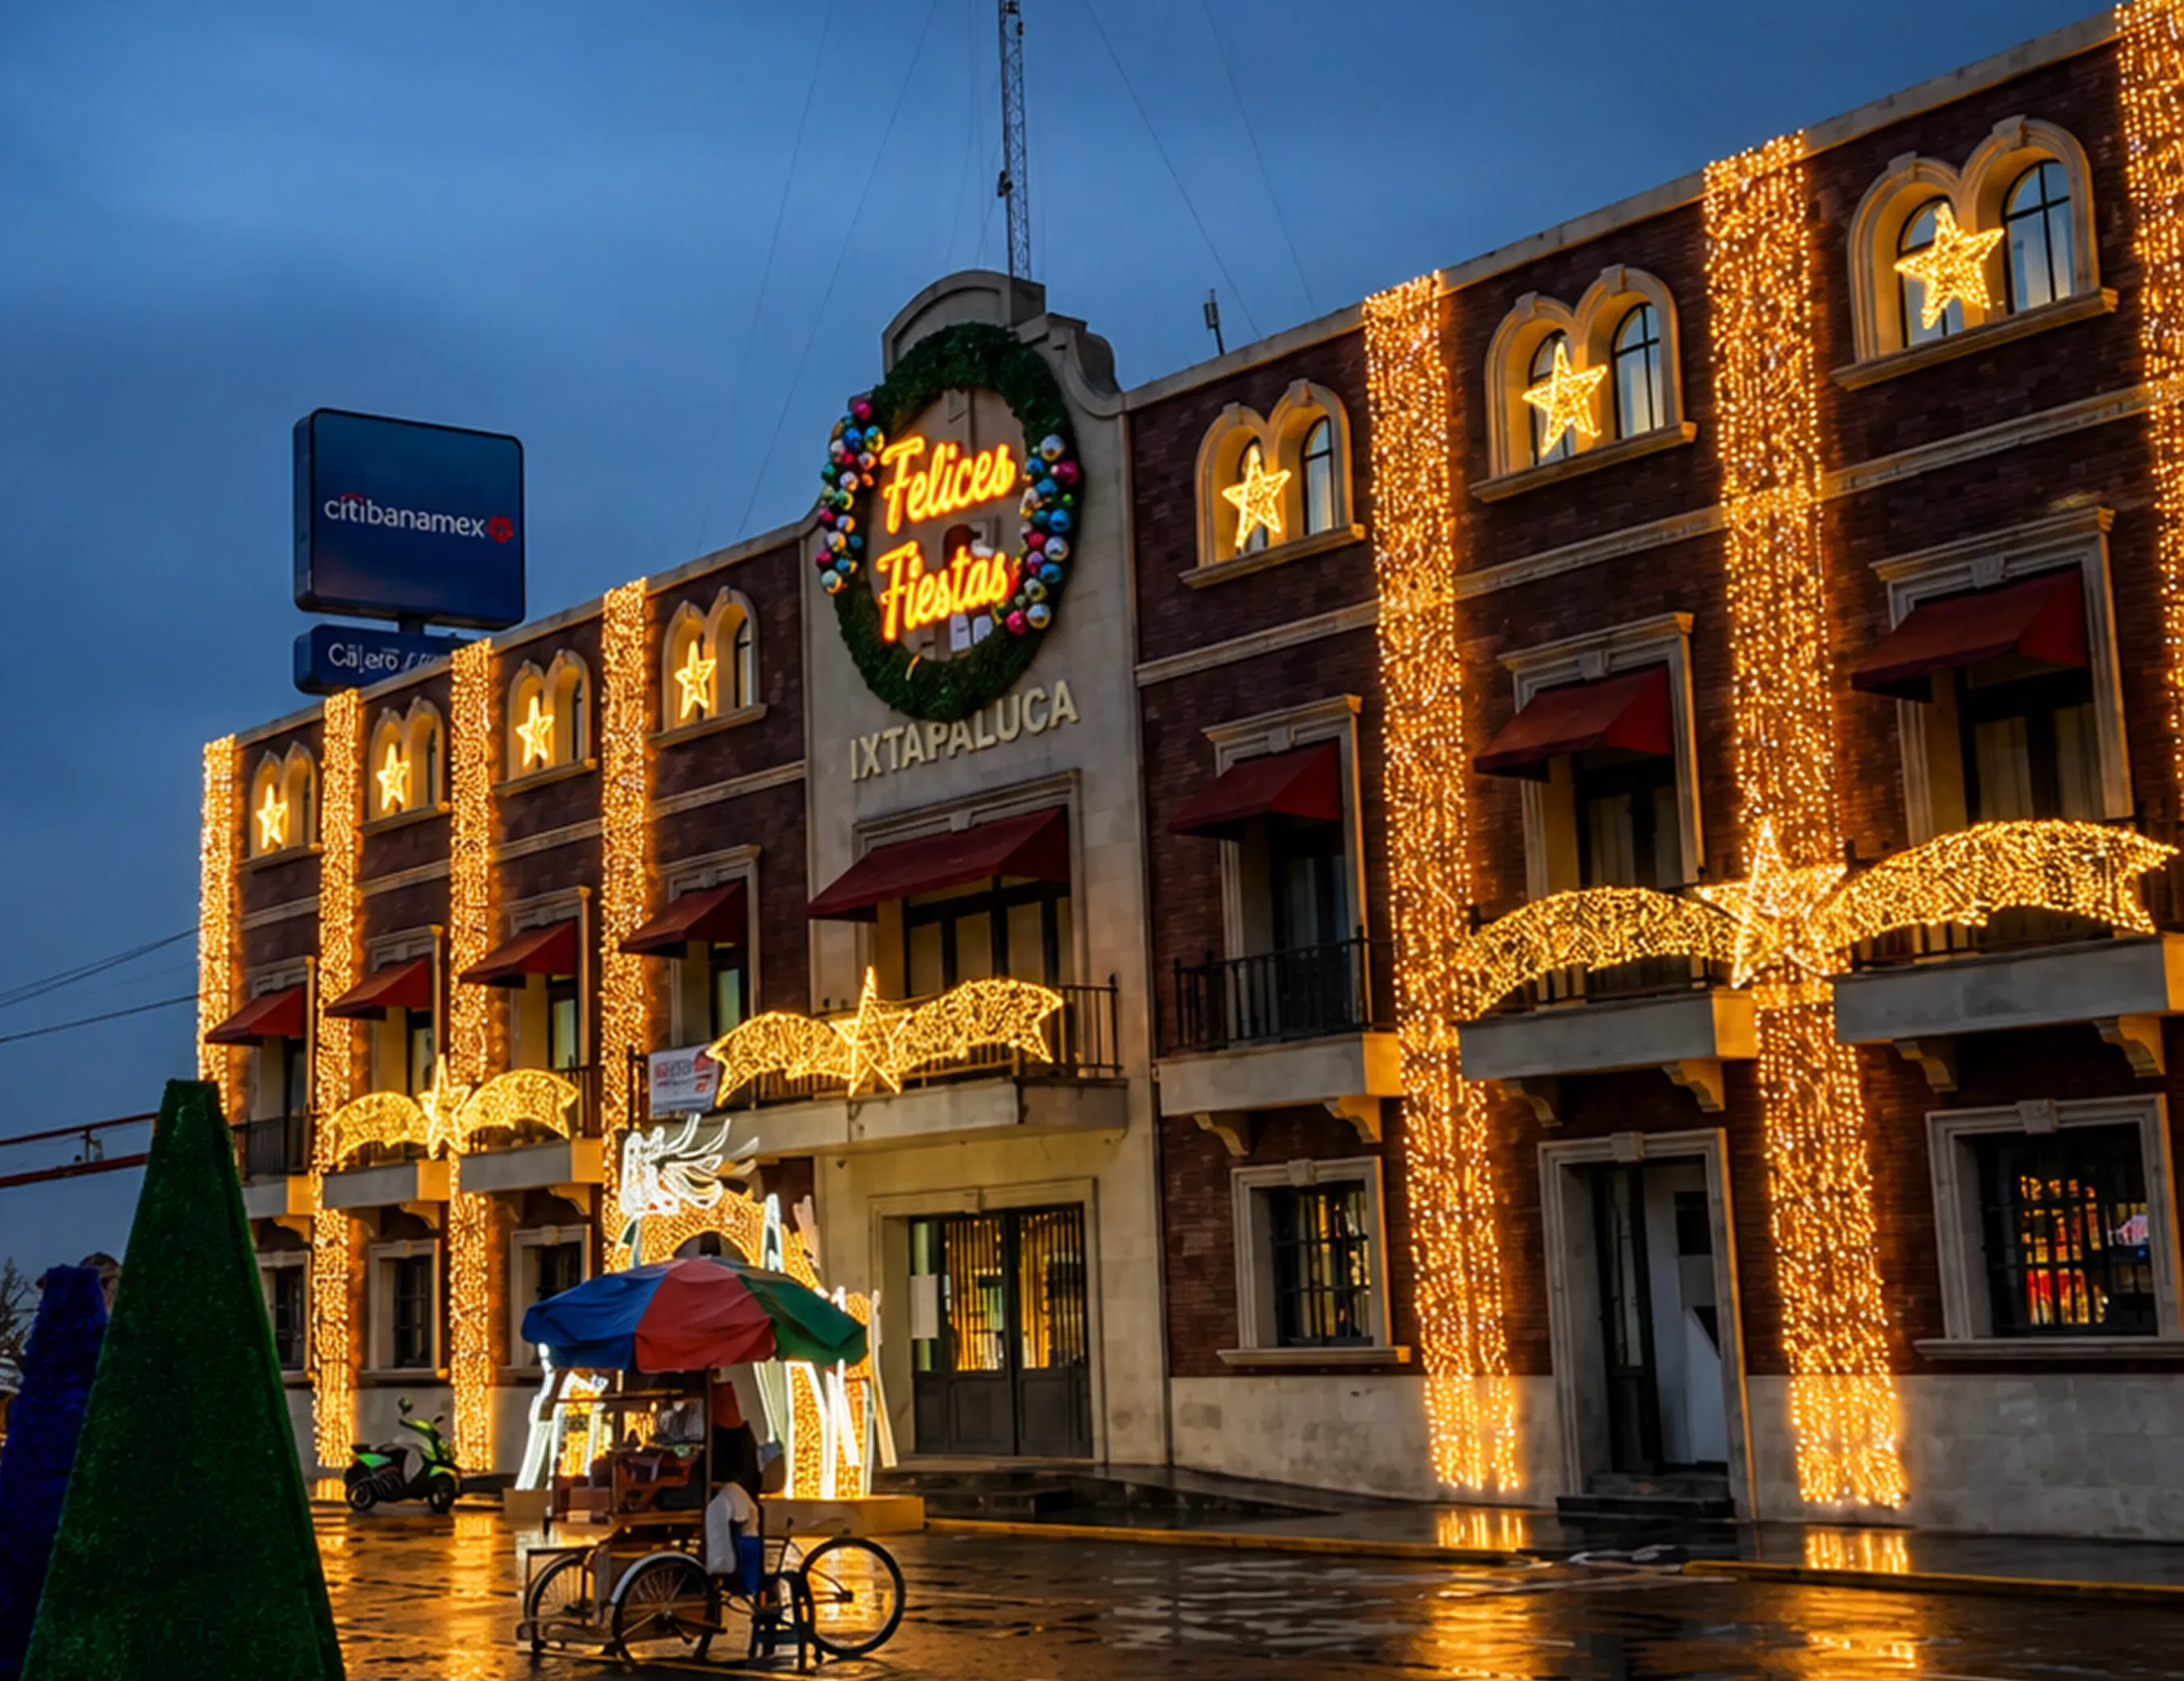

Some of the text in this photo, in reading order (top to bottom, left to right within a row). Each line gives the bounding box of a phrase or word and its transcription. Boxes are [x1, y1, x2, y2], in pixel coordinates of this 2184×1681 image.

[324, 494, 486, 538] citibanamex
[879, 436, 1017, 535] Felices
[875, 540, 1009, 641] Fiestas
[850, 679, 1079, 782] IXTAPALUCA
